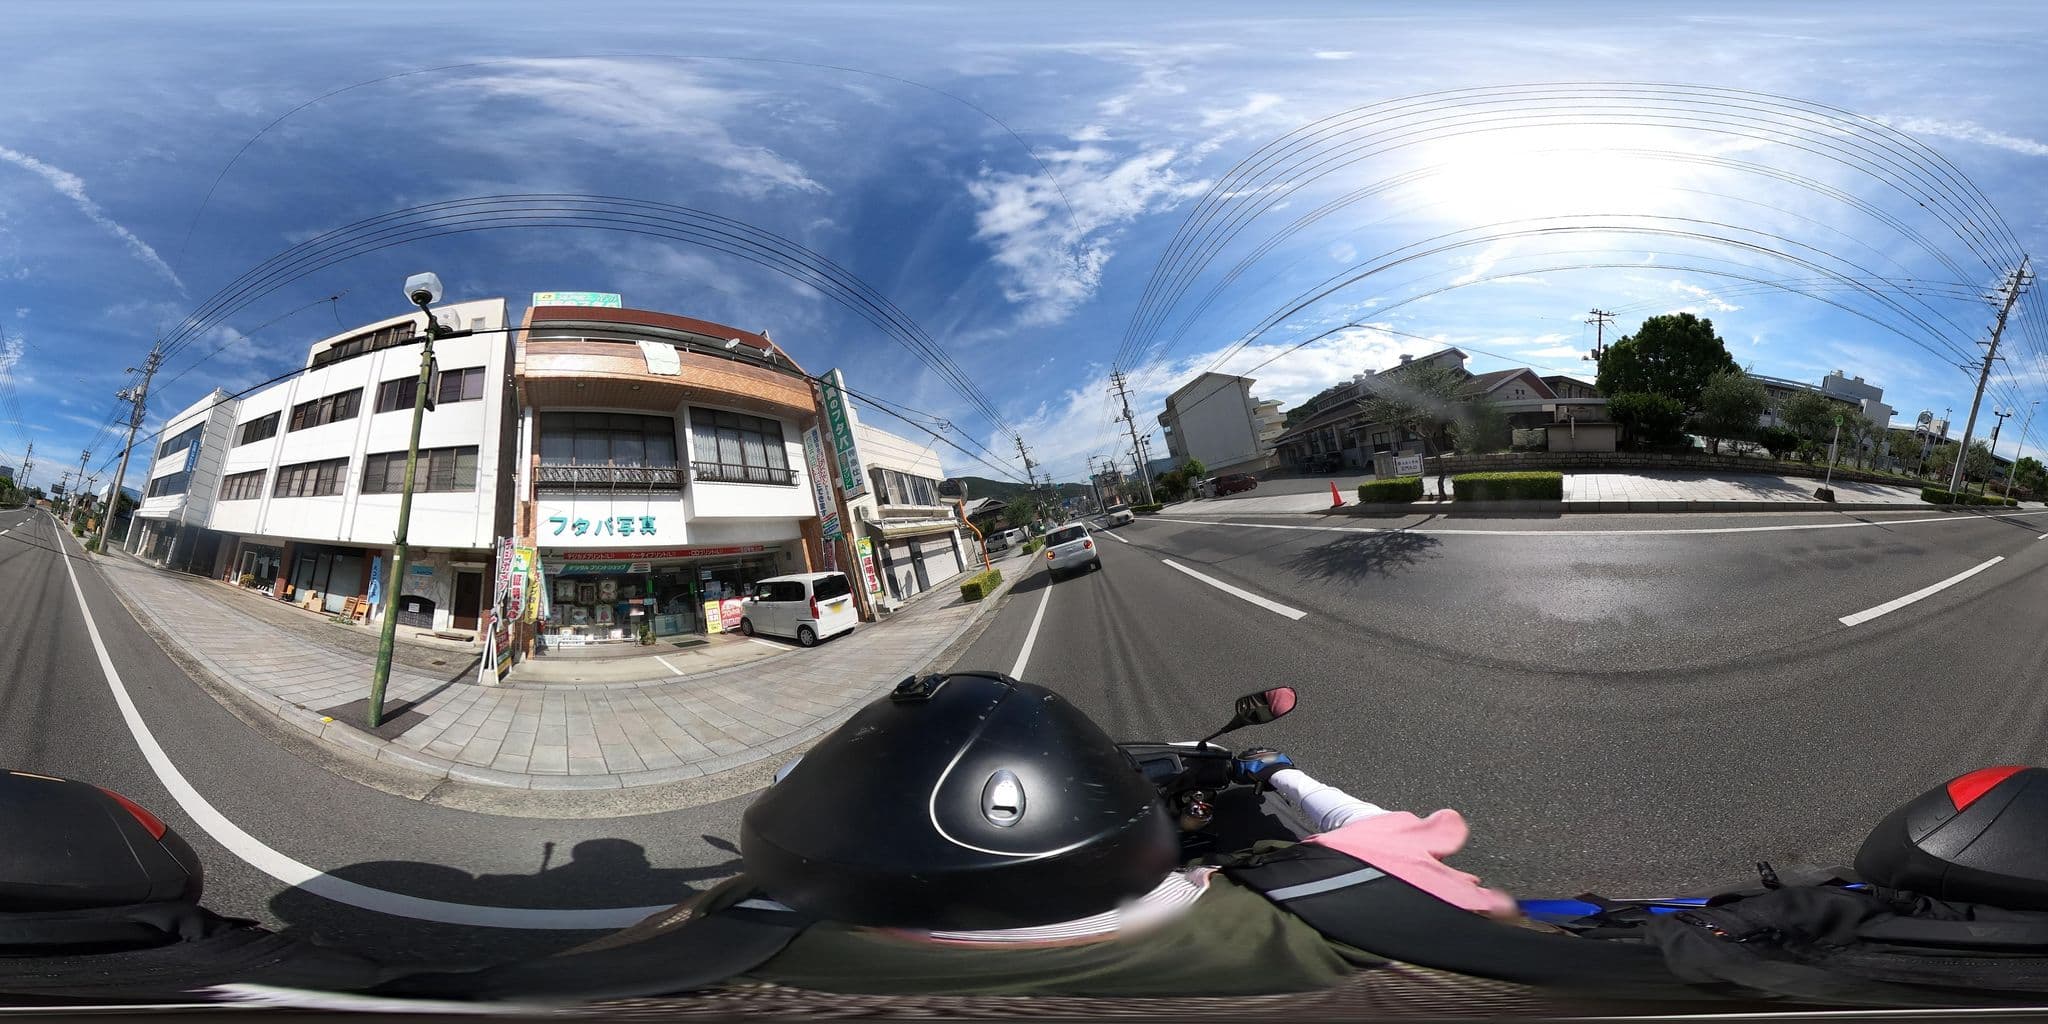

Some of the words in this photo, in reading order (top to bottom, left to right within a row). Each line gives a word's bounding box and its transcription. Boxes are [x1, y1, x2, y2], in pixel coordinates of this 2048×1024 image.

[549, 516, 657, 536] フタバ写真
